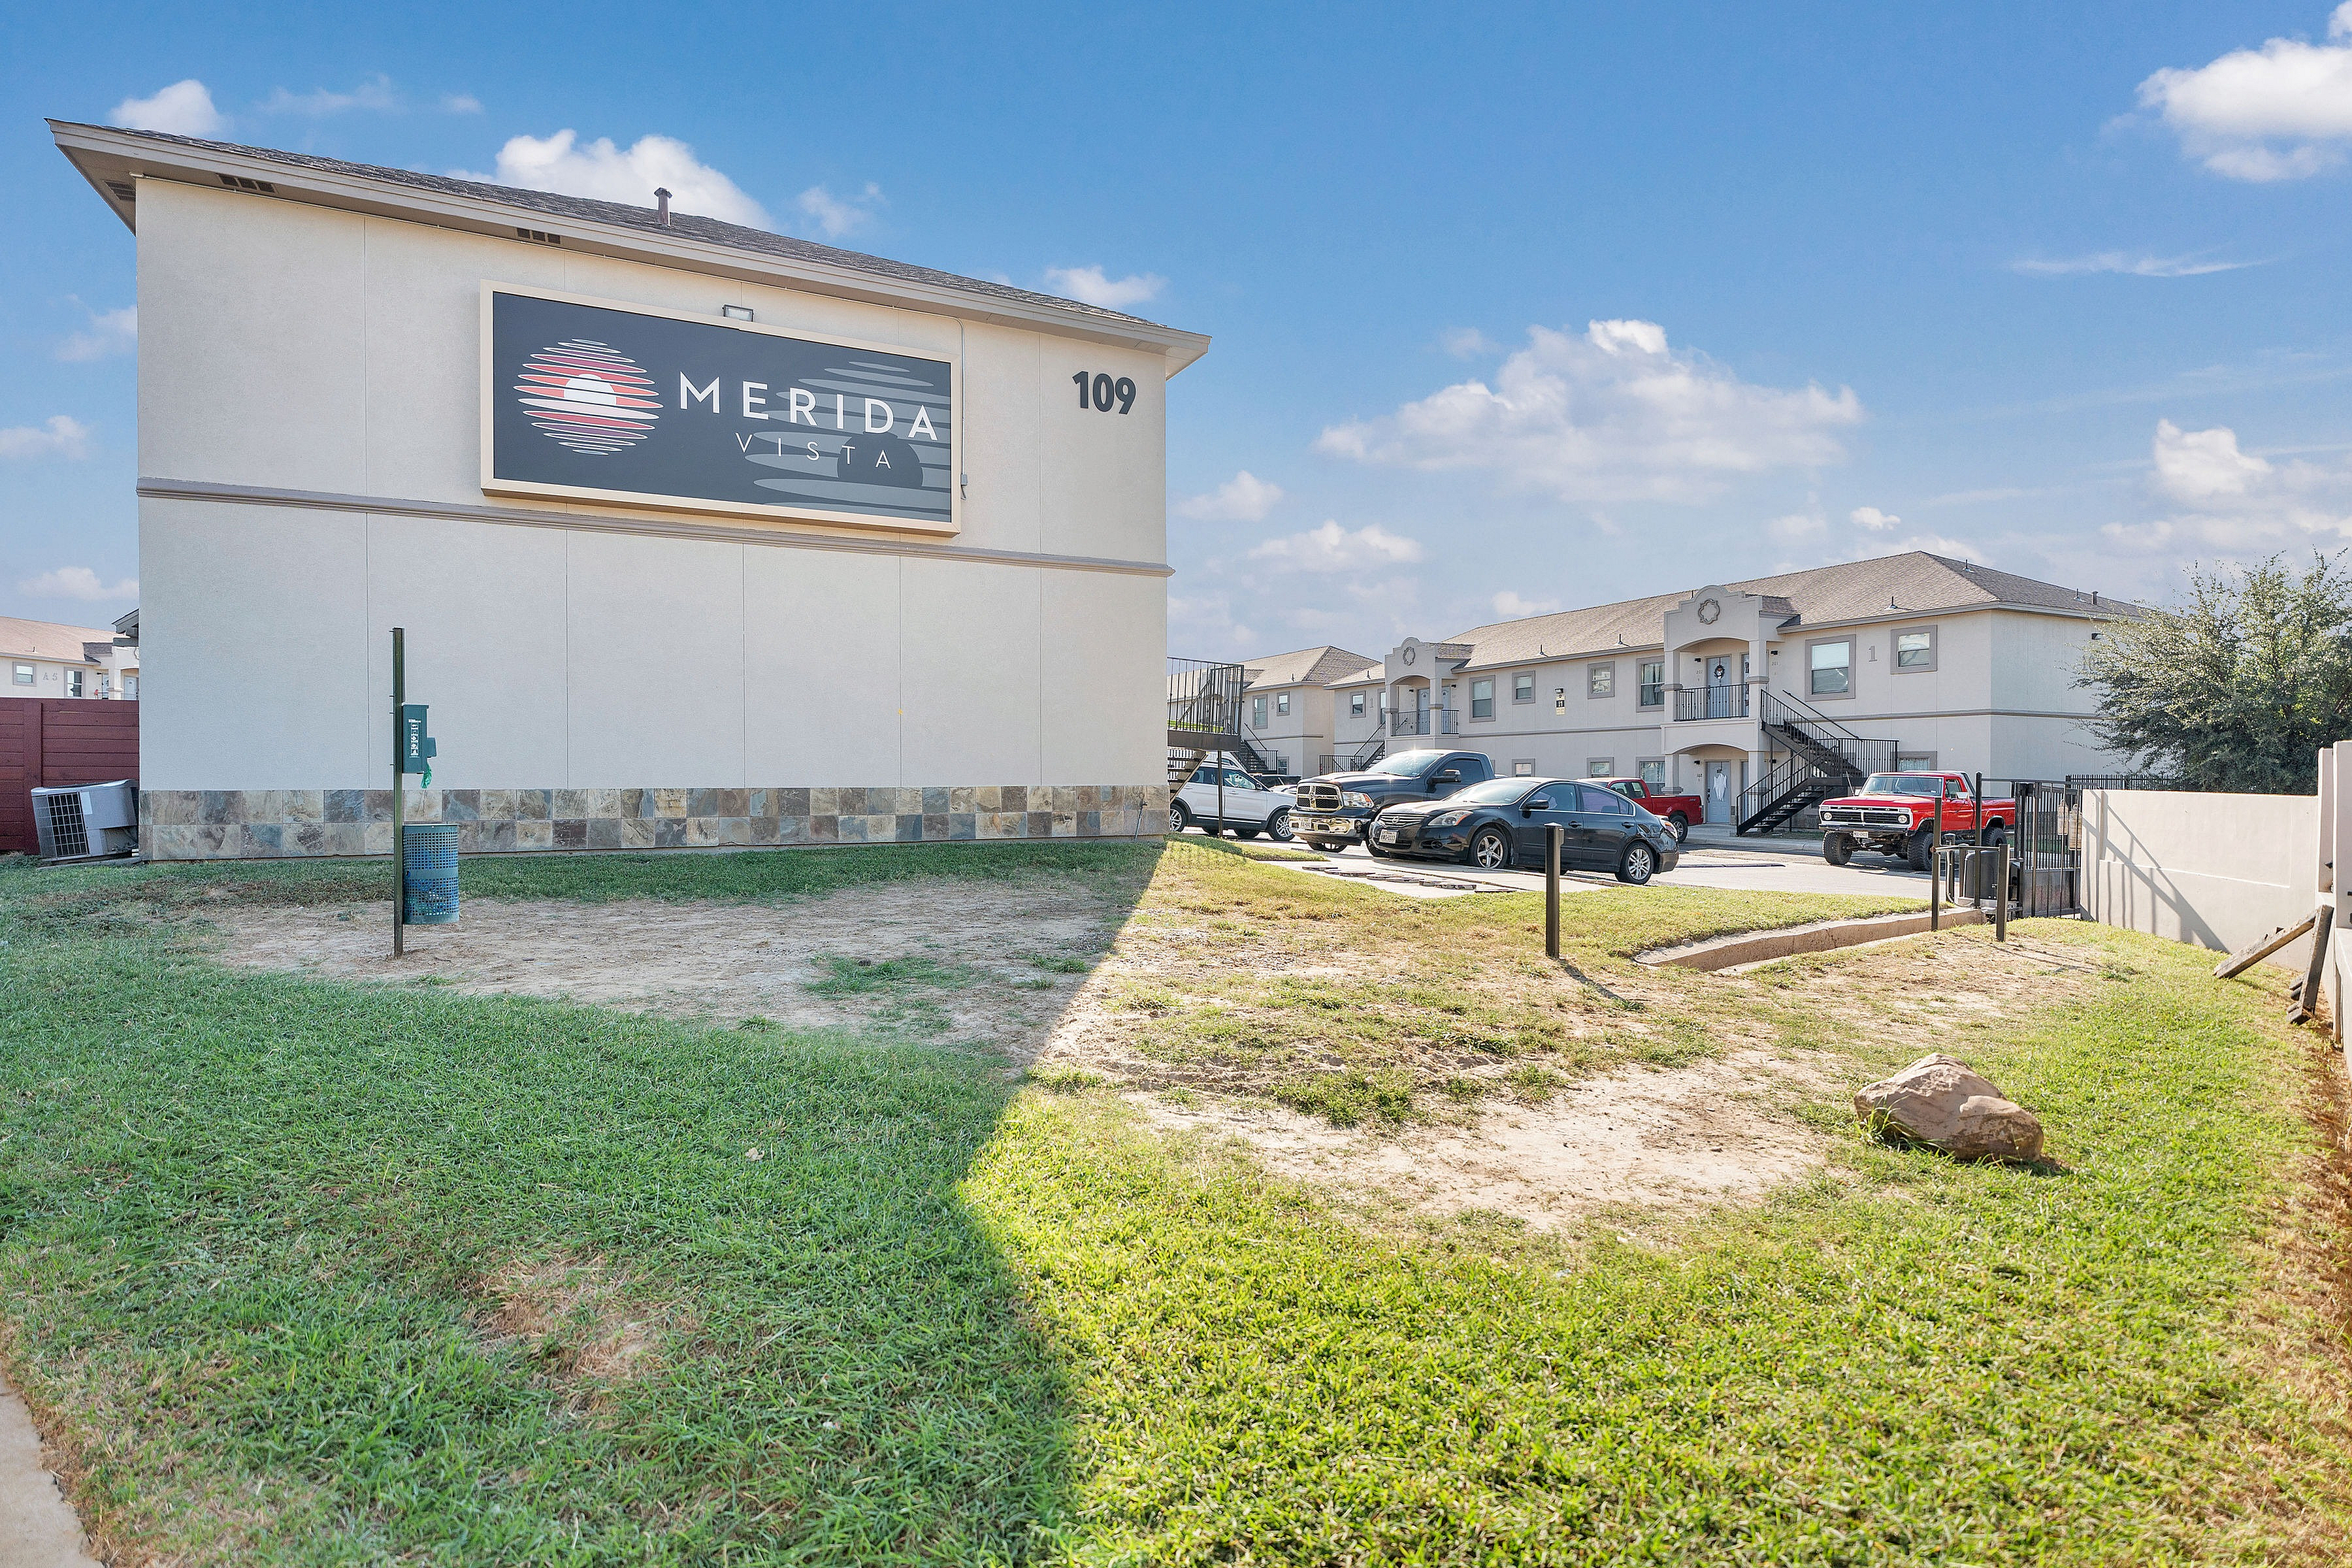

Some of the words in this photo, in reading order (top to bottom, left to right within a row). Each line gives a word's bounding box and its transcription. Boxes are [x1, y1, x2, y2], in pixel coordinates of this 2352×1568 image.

[679, 370, 939, 441] MERIDA
[1071, 370, 1137, 416] 109
[735, 433, 892, 469] VISTA
[1868, 645, 1878, 662] 1
